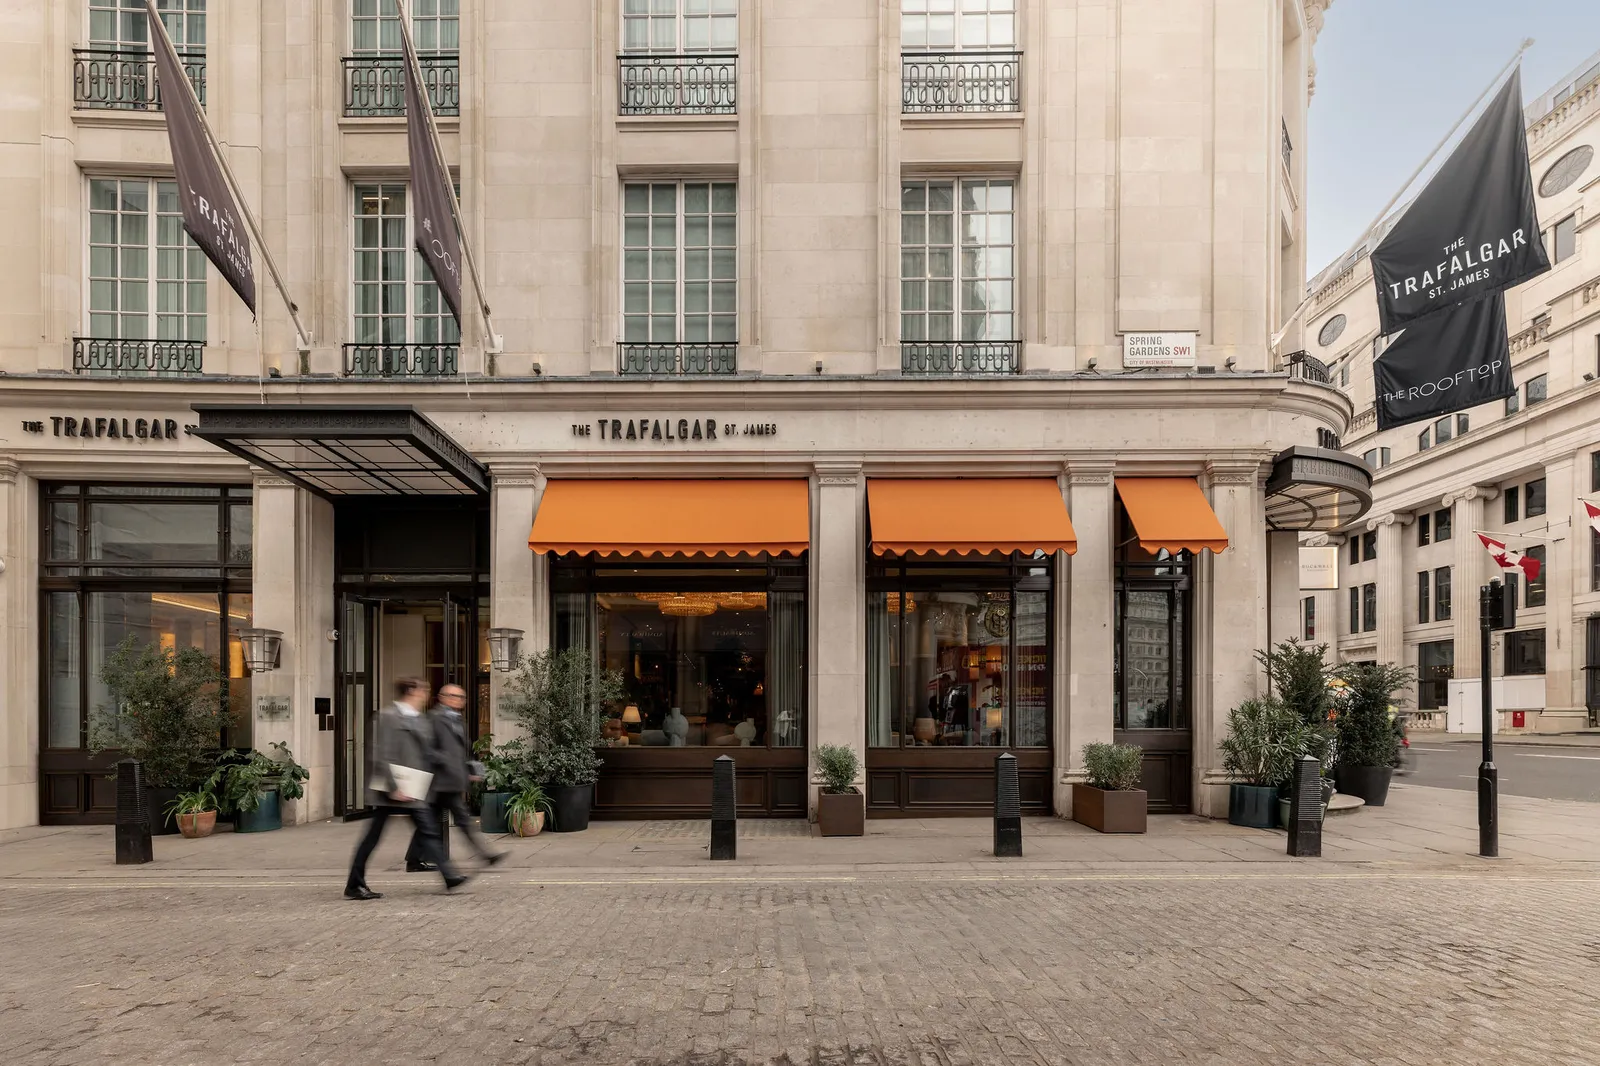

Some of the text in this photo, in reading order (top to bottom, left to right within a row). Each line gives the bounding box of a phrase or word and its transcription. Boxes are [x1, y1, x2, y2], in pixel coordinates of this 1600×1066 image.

[1443, 236, 1466, 255] THE
[1389, 228, 1527, 300] TRAFALGAR
[1428, 268, 1490, 299] ST. JAMES
[1129, 336, 1162, 345] SPRING
[1129, 346, 1191, 356] GARDENS SW1
[1383, 359, 1502, 402] THE ROOFTOP
[21, 420, 44, 433] THE
[50, 416, 178, 439] TRAFALGAR
[571, 418, 777, 440] THE TRAFALGAR ST. JAMES
